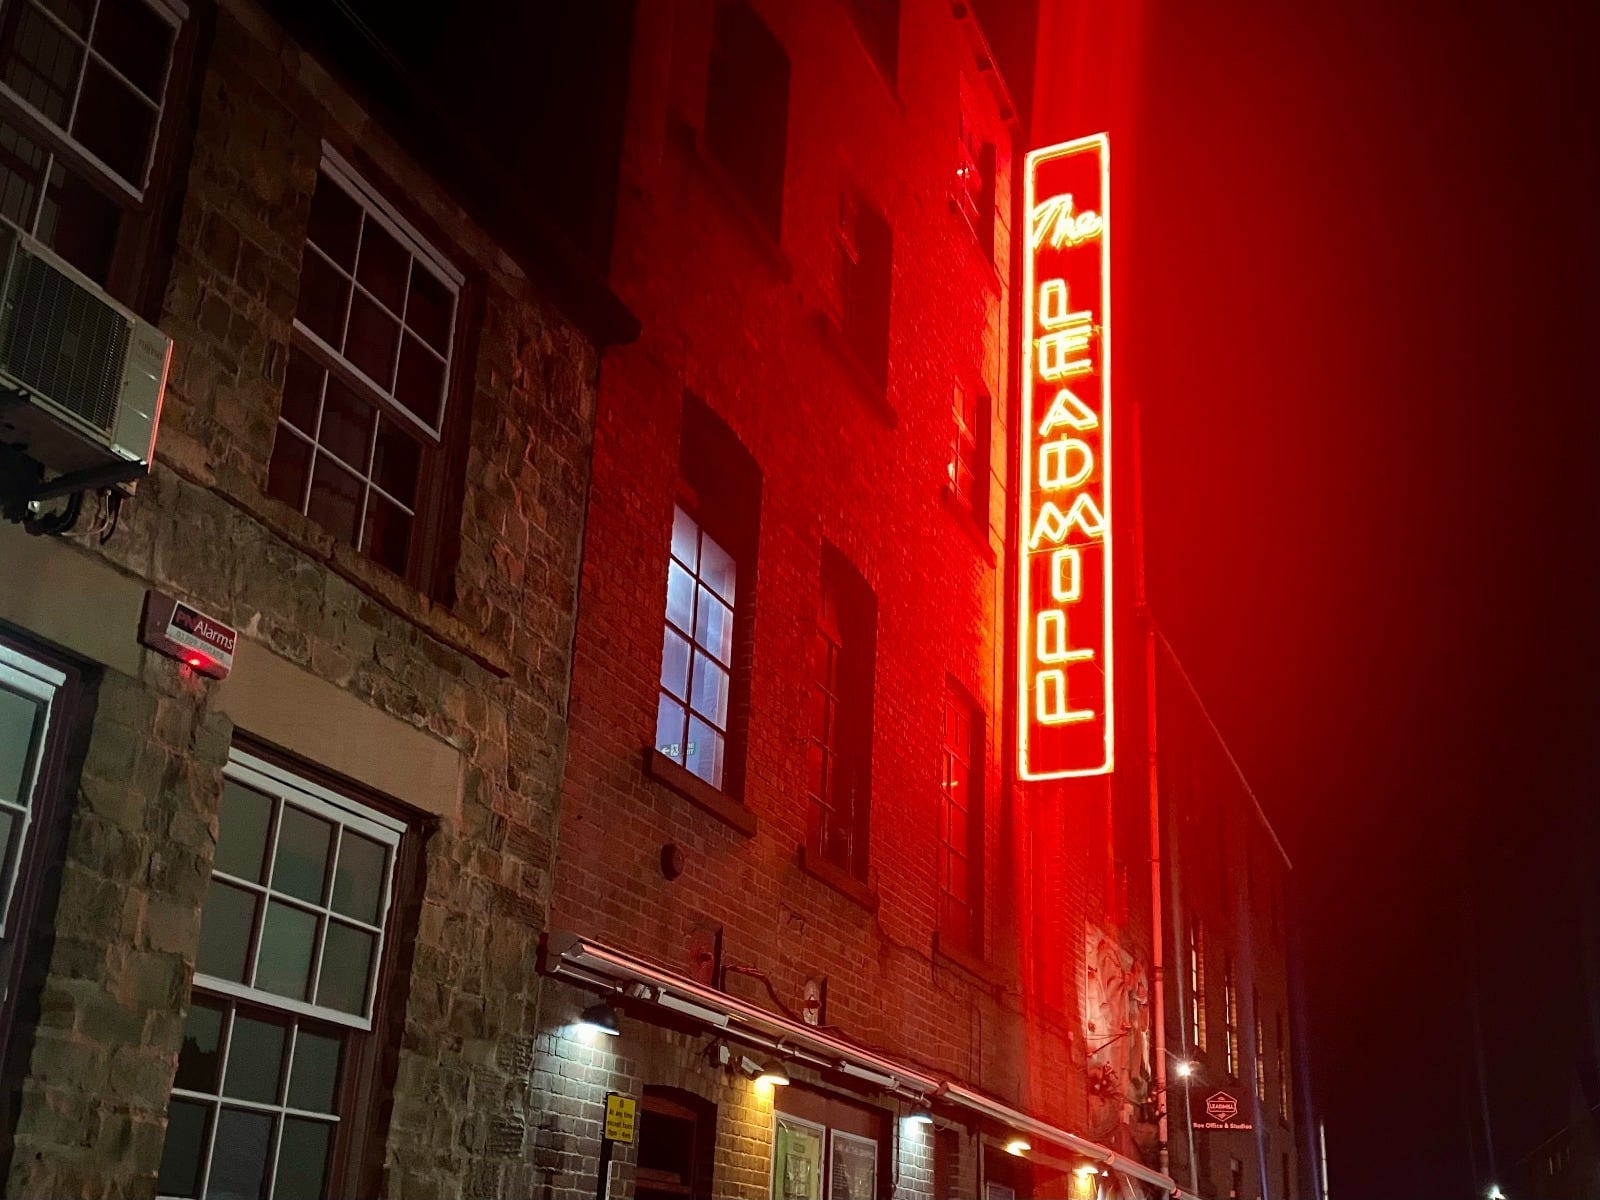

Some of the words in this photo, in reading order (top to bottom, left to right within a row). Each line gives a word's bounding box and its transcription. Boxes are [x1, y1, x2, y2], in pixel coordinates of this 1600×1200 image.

[1033, 193, 1104, 249] The
[1030, 277, 1106, 726] LEADMILL
[193, 620, 234, 650] Alarms
